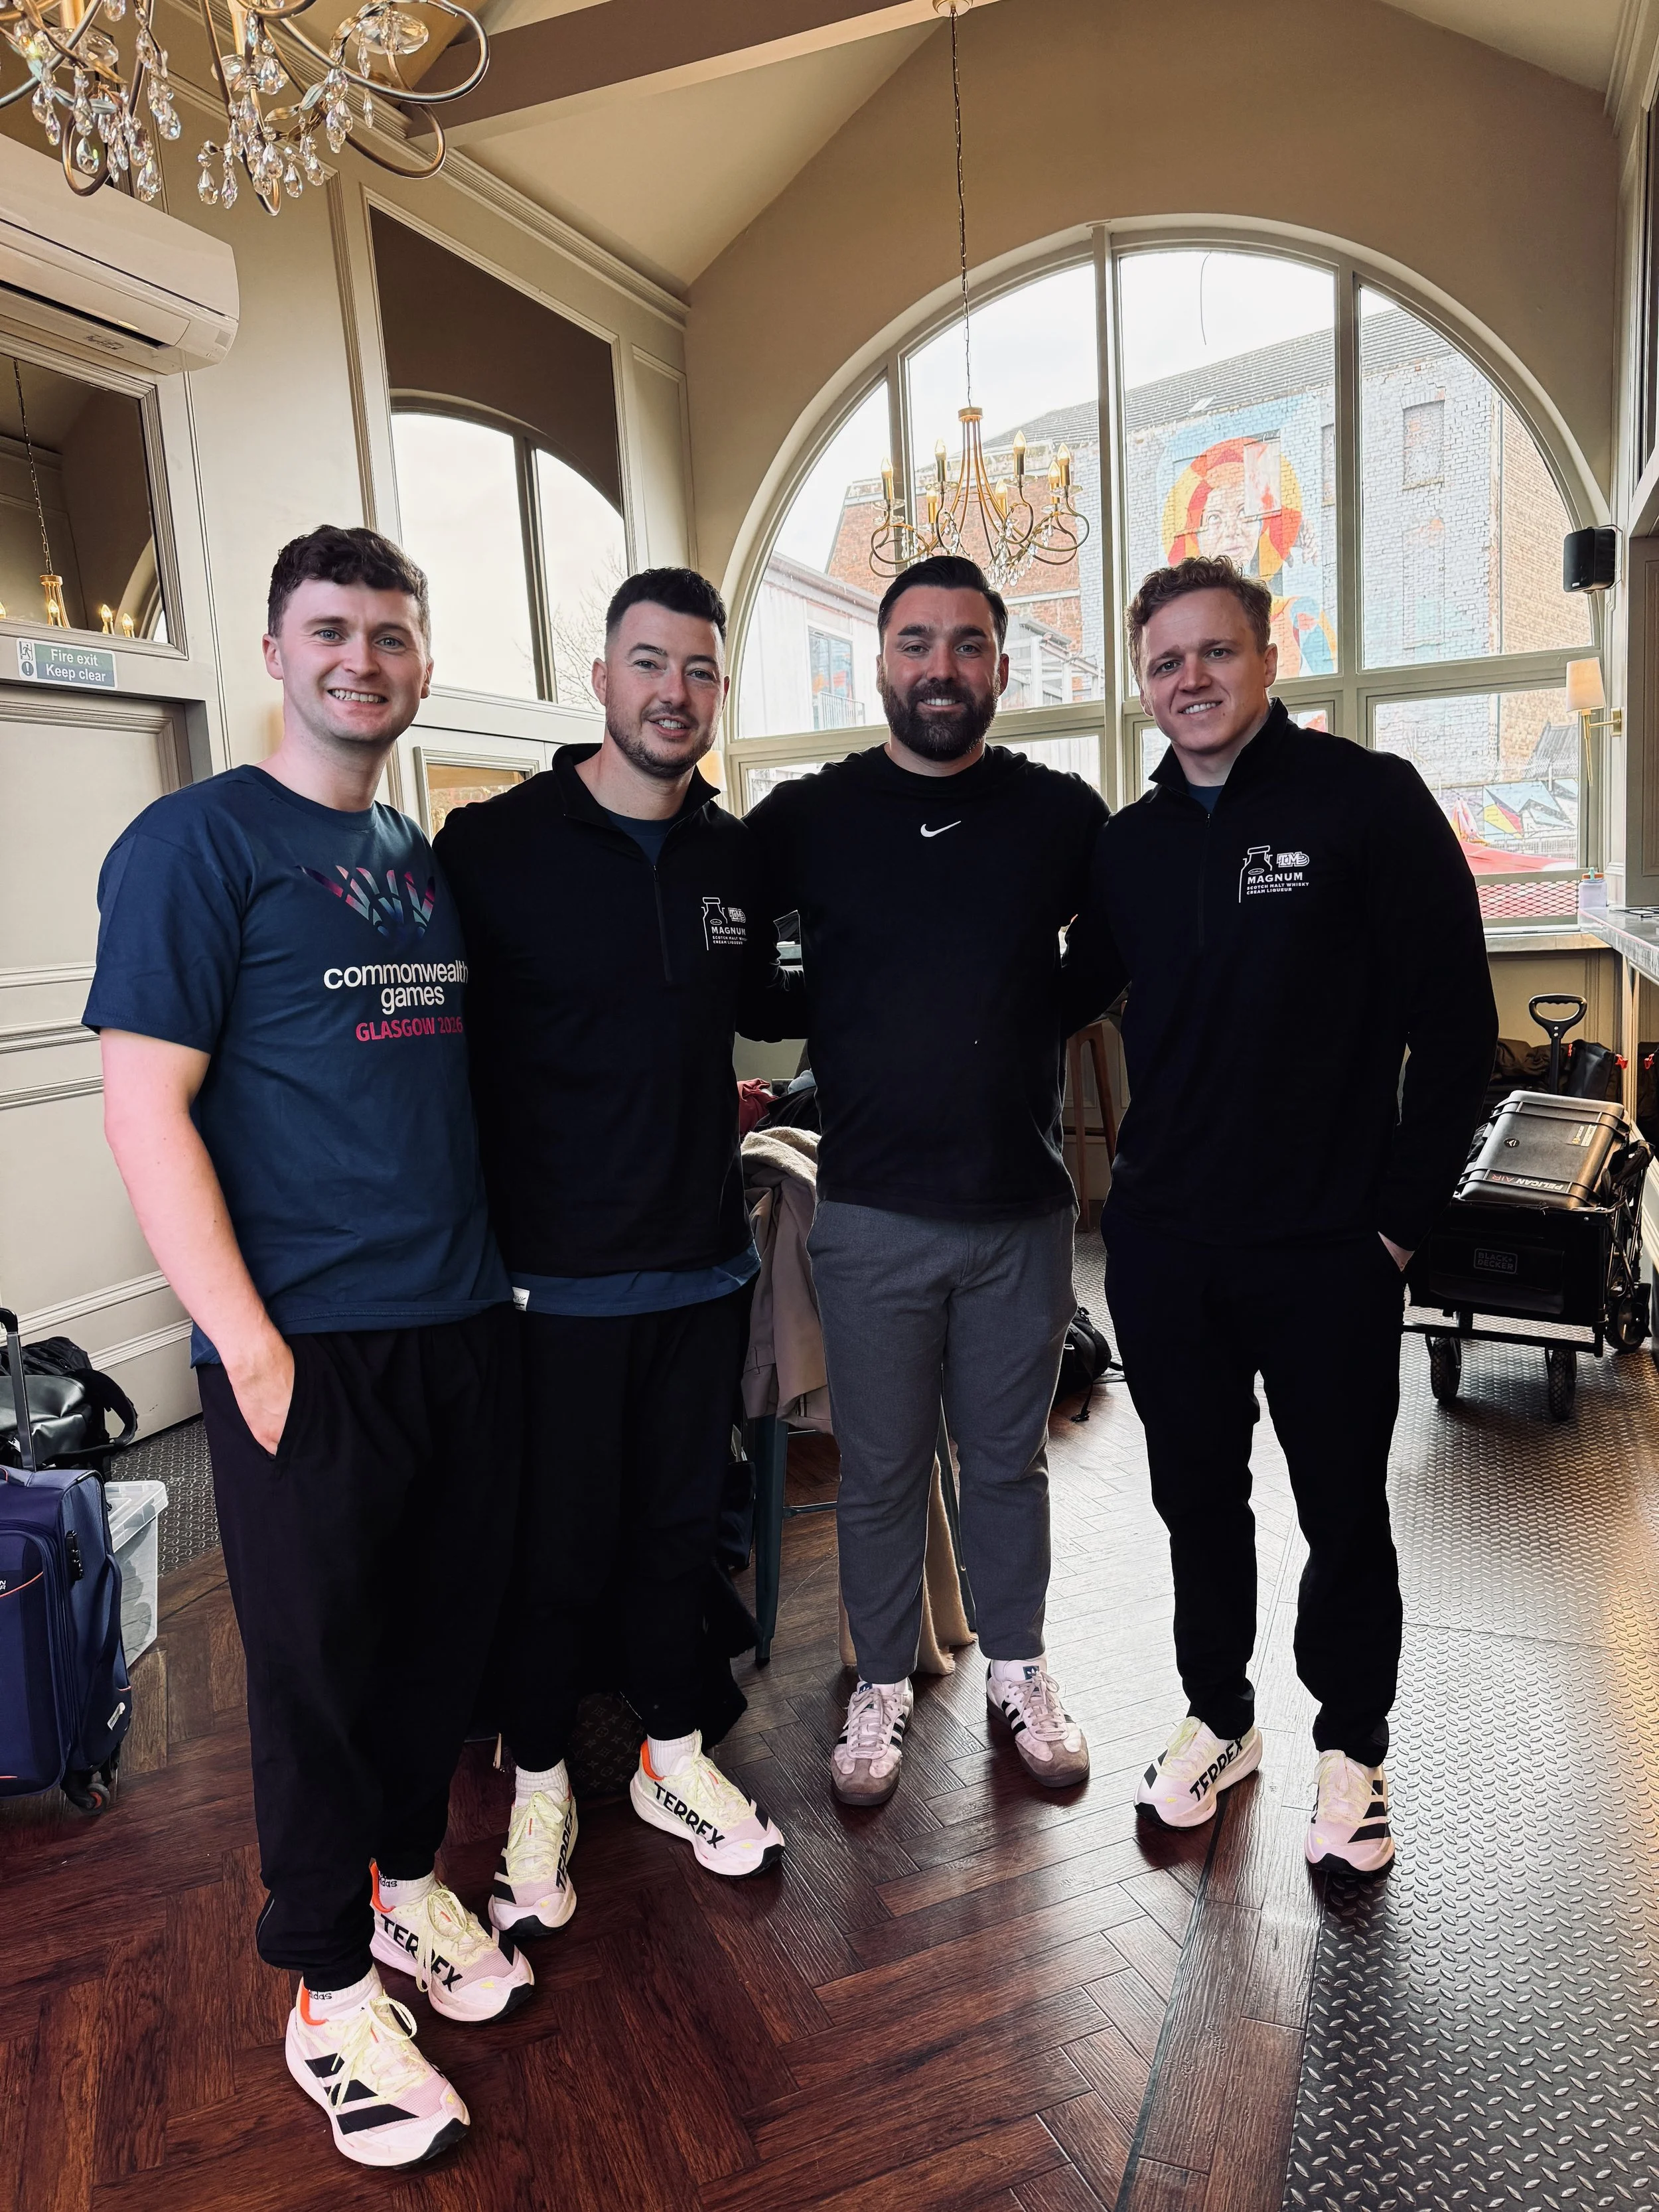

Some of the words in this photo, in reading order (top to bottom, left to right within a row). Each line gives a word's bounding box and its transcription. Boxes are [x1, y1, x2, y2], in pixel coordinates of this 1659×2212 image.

[50, 648, 74, 663] Fire
[77, 654, 98, 666] exit
[46, 664, 75, 680] Keep
[79, 669, 106, 682] clear
[1248, 872, 1303, 885] MAGNUM
[324, 960, 469, 989] commonwealth
[381, 986, 445, 1015] games
[356, 1017, 435, 1041] GLASGOW
[439, 1017, 463, 1034] 2026
[1492, 1173, 1514, 1183] AIR
[1516, 1178, 1563, 1191] PELICAN
[1478, 1258, 1513, 1270] DECKER
[1190, 1737, 1243, 1802] TERREX
[654, 1781, 725, 1850] TERREX
